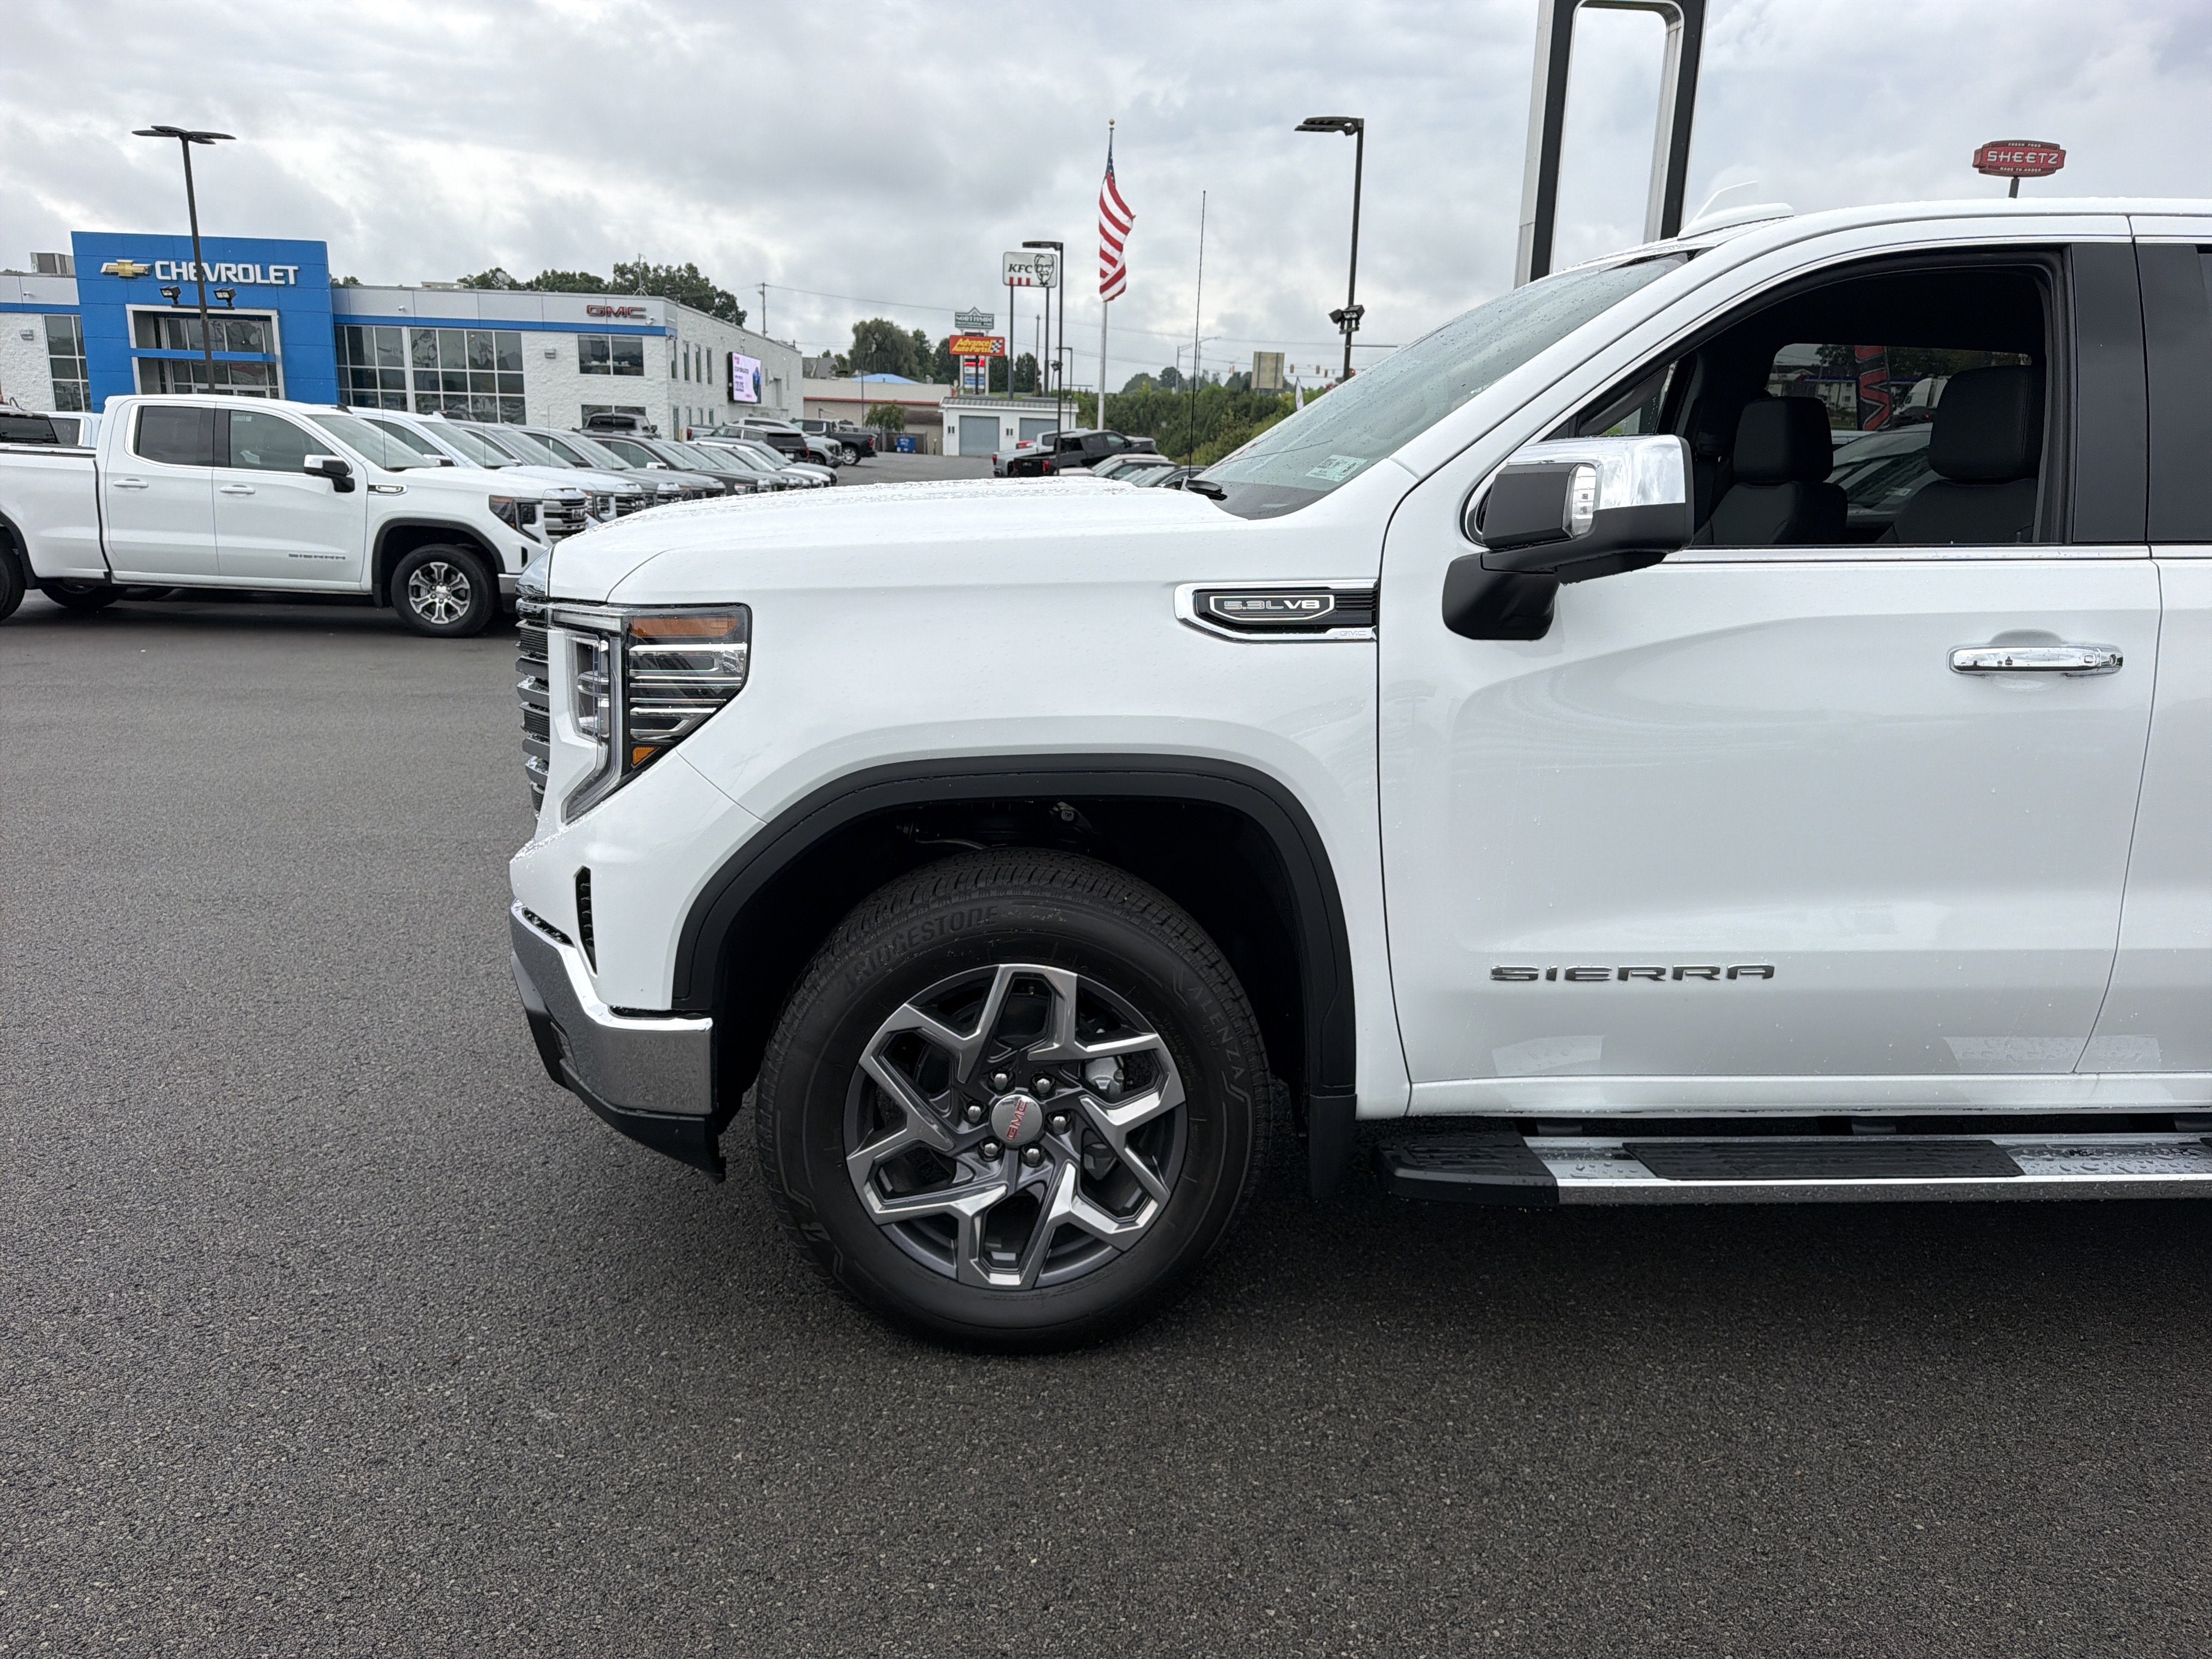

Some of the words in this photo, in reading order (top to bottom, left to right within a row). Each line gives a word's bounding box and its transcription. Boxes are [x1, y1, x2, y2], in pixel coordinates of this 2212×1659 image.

[1987, 151, 2059, 165] SHEETZ
[155, 261, 299, 285] CHEVROLET
[1008, 263, 1033, 273] KFC
[586, 304, 646, 319] GMC
[957, 338, 989, 347] Advance
[1224, 601, 1284, 610] 5.3L
[1284, 600, 1320, 609] V8
[1490, 964, 1775, 982] SIERRA
[1188, 986, 1245, 1080] ALENZA
[1006, 1098, 1028, 1140] GMC
